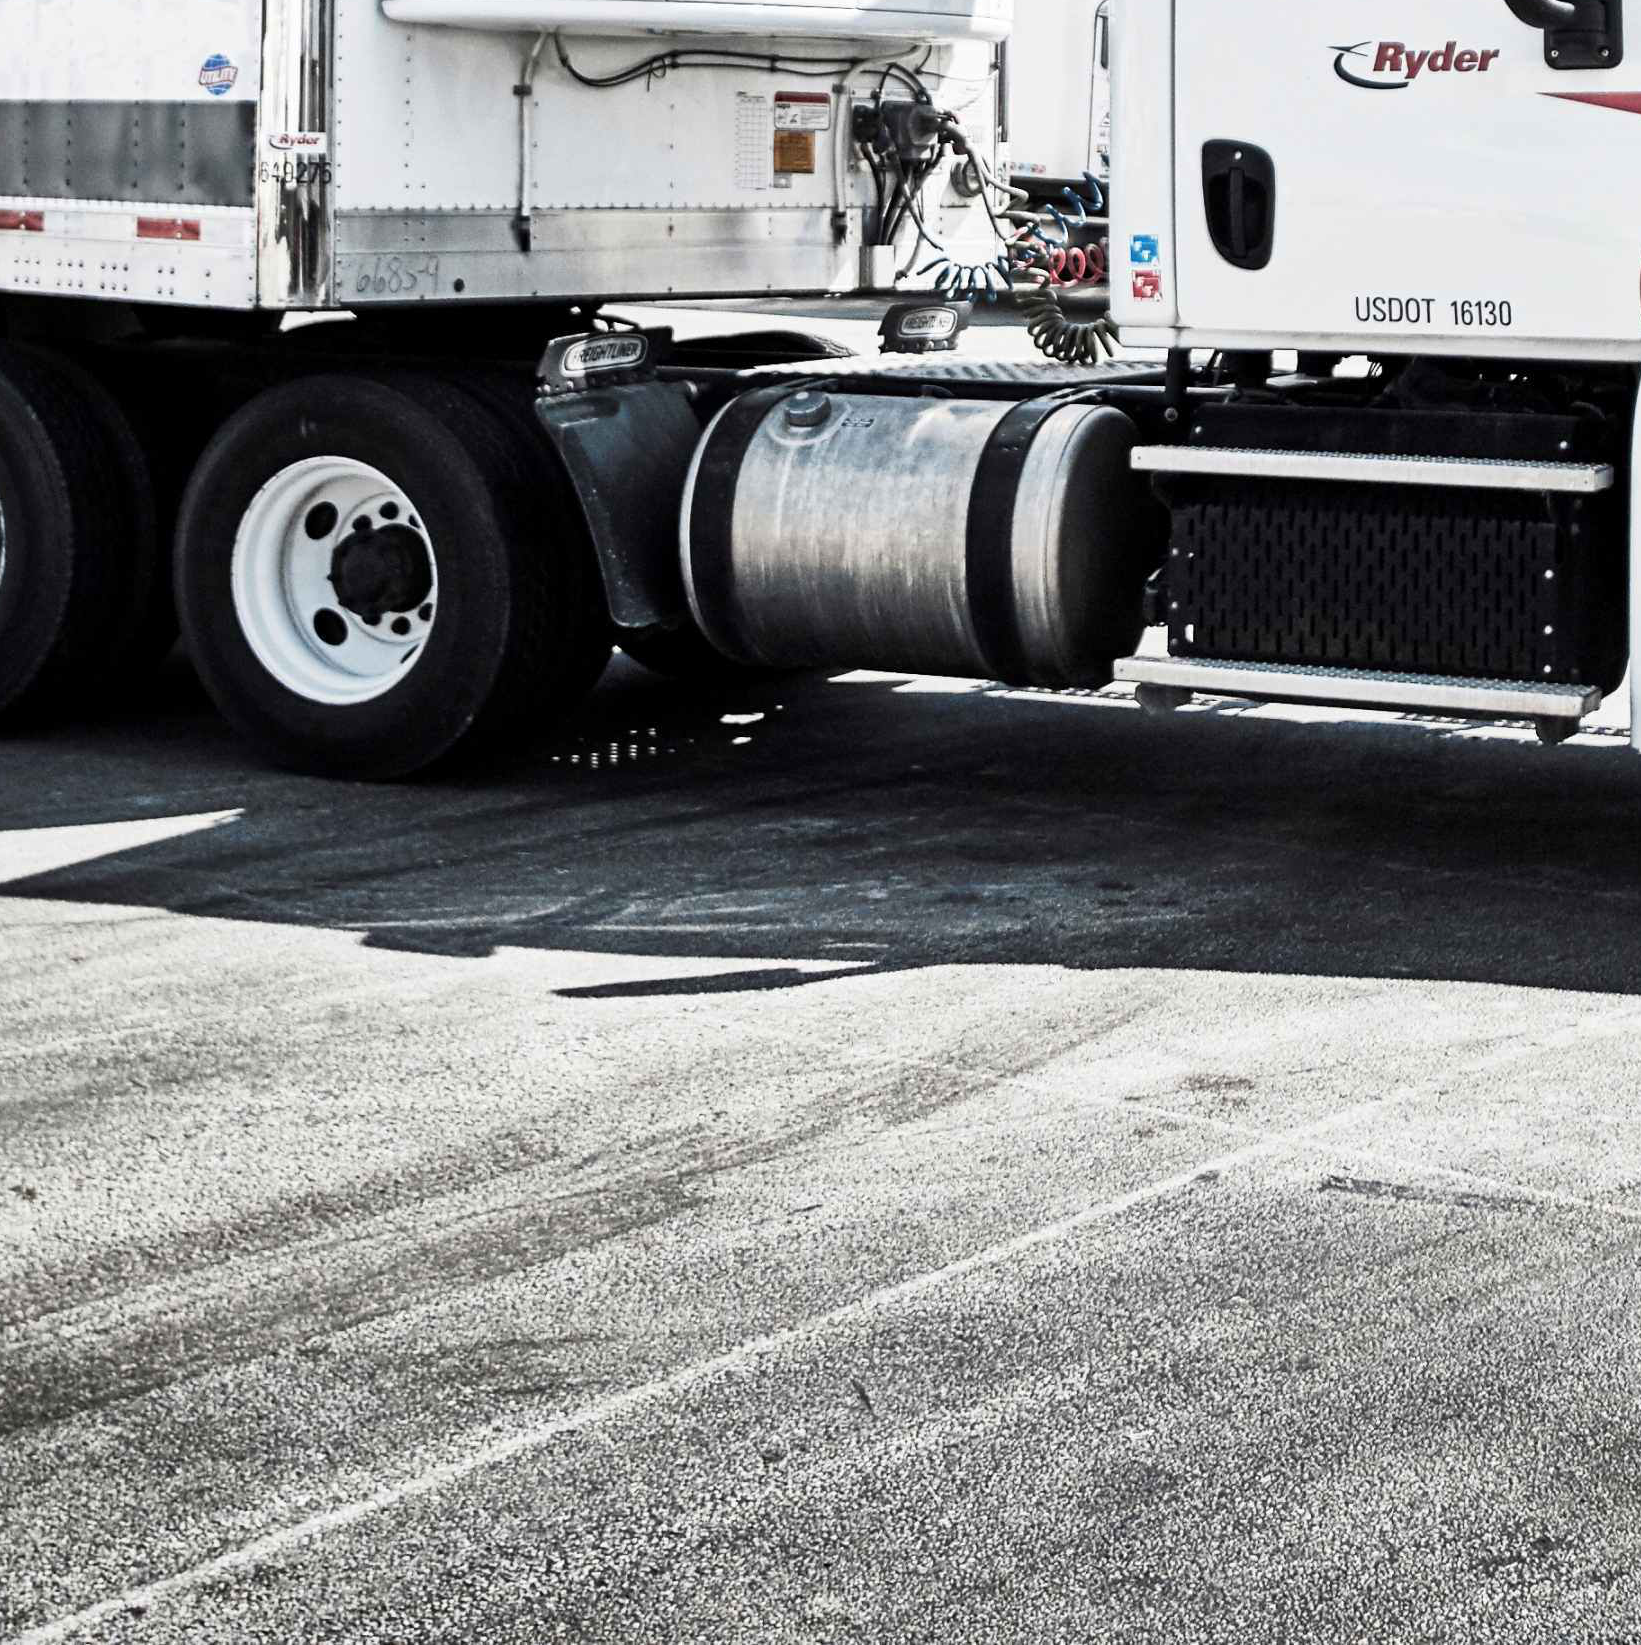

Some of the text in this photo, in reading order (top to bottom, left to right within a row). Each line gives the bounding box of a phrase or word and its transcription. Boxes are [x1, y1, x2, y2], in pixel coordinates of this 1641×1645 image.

[1373, 40, 1501, 79] Ryder
[278, 133, 320, 147] Ryder
[1355, 297, 1512, 327] USDOT 16130
